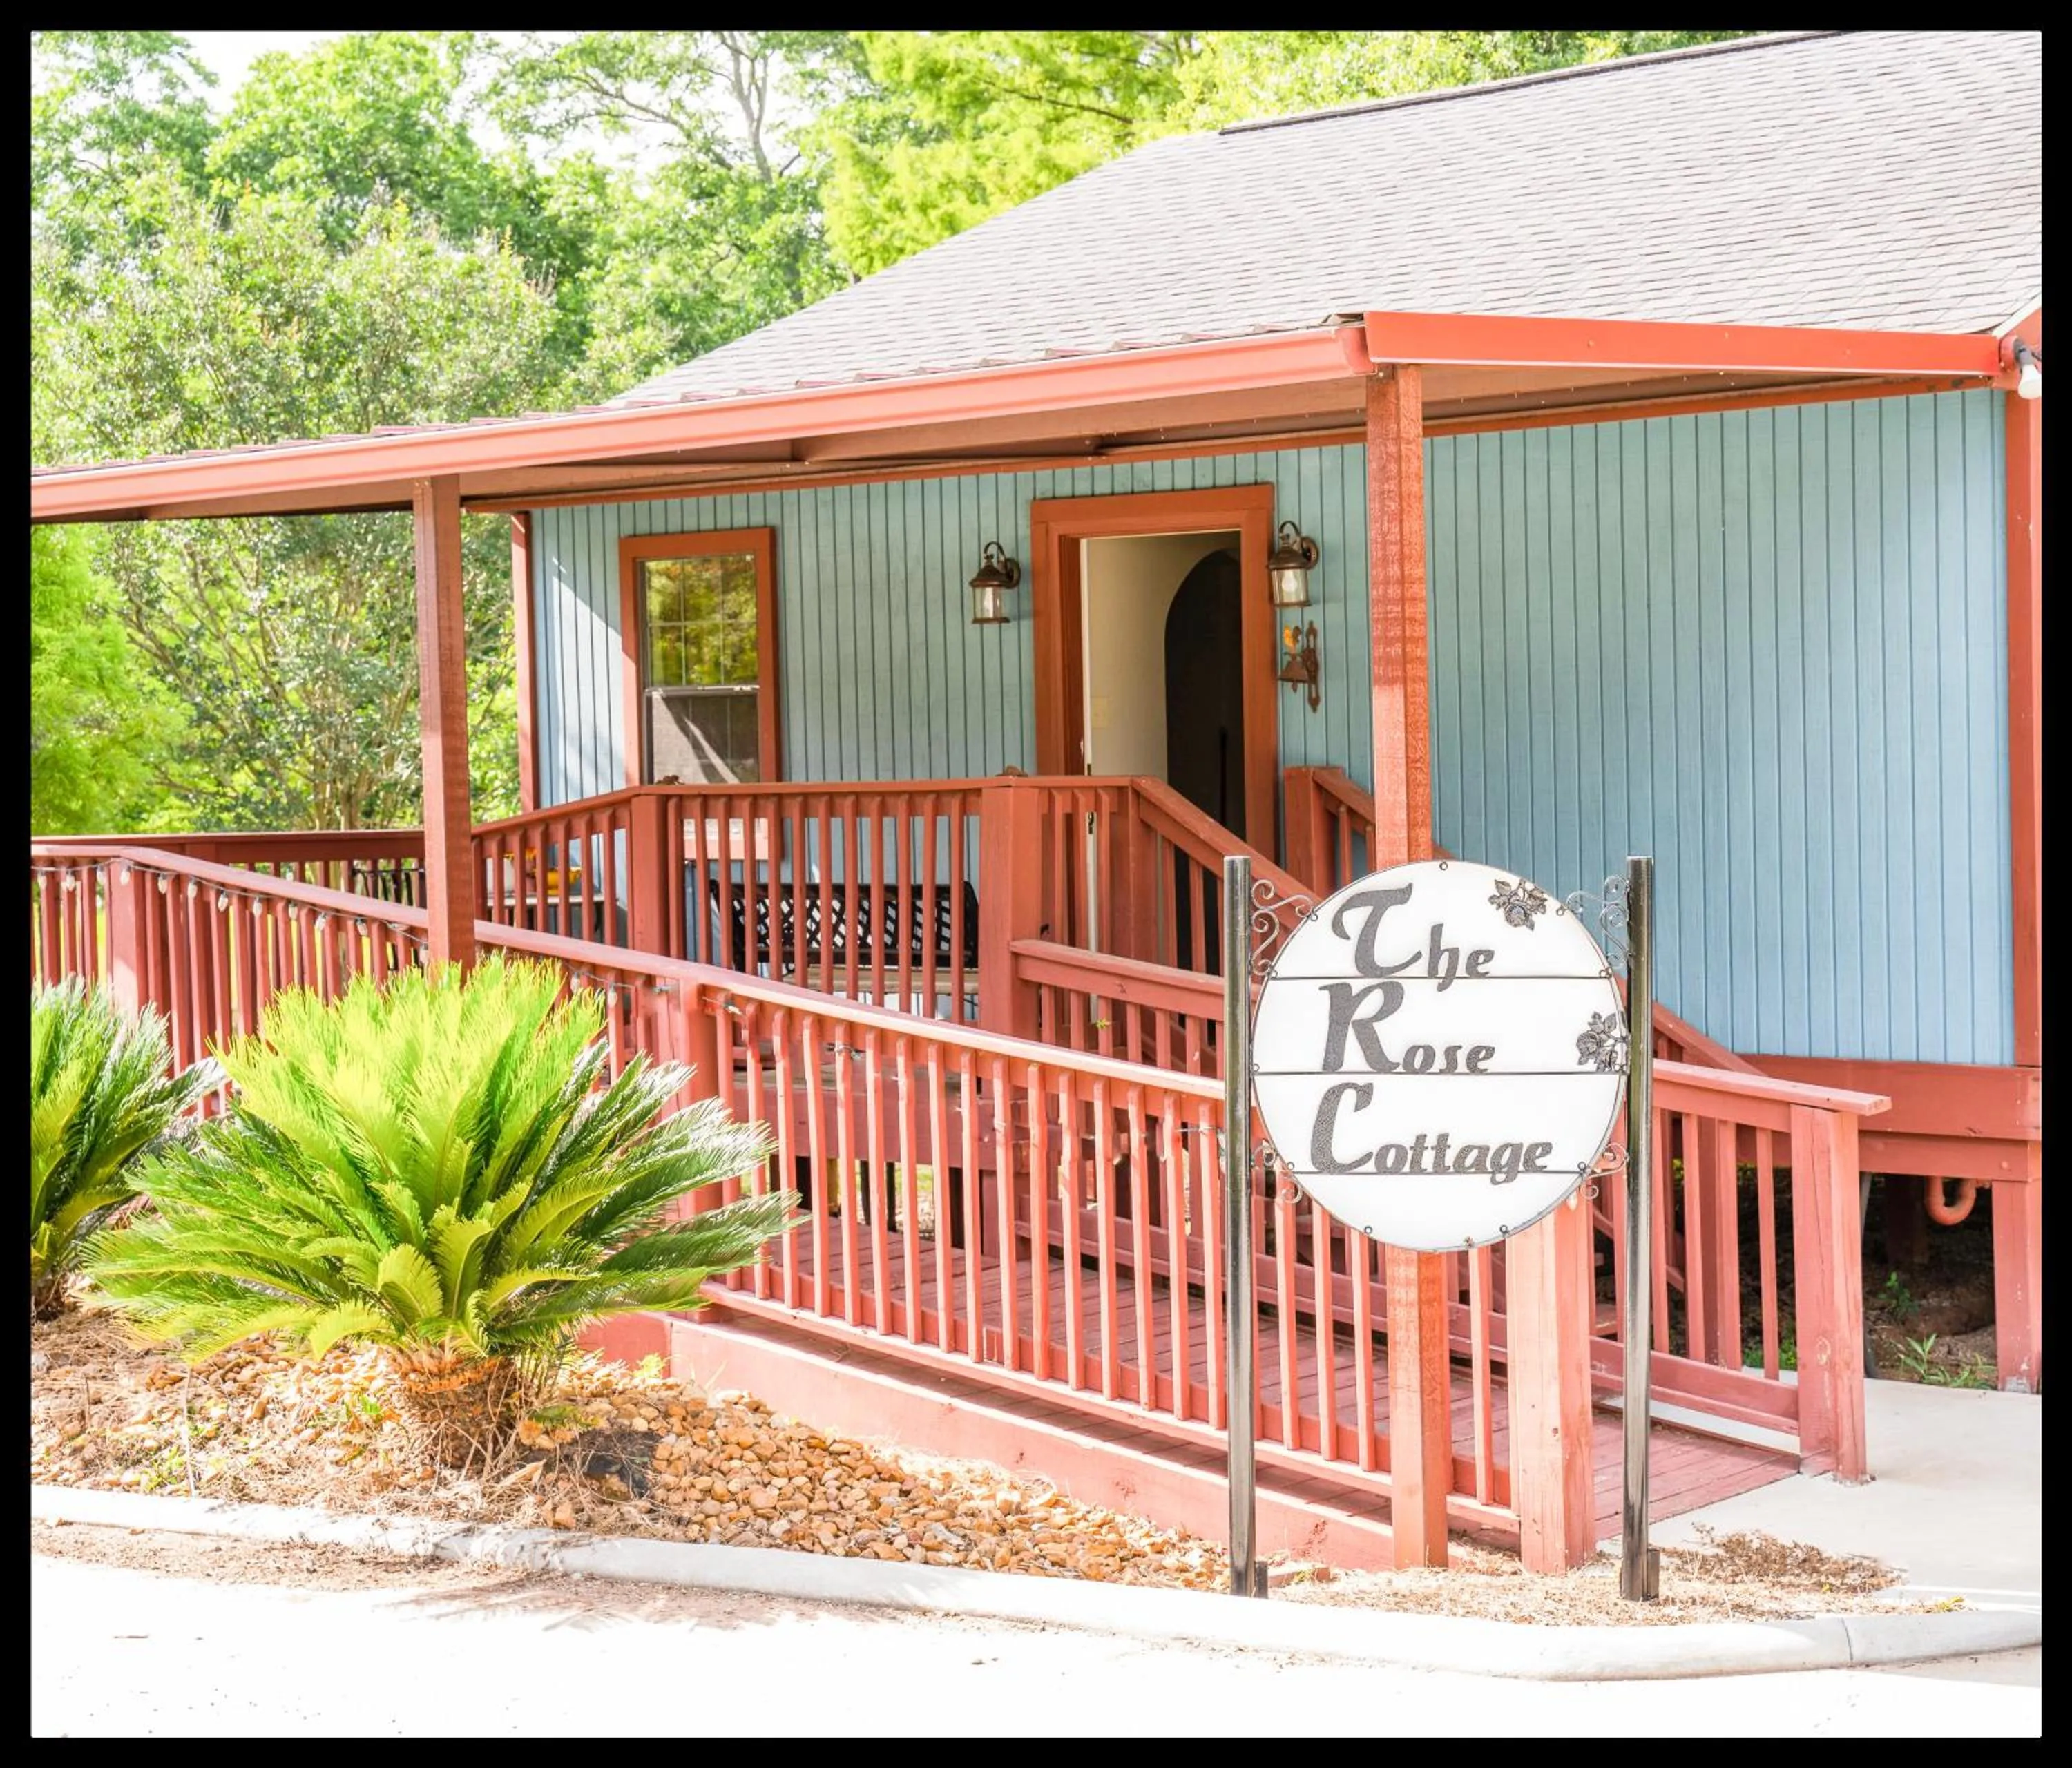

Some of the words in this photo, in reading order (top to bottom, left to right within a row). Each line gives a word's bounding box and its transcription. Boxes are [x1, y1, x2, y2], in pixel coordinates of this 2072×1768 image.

[1331, 883, 1495, 992] The
[1318, 980, 1495, 1073] Rose
[1310, 1082, 1553, 1186] Cottage
